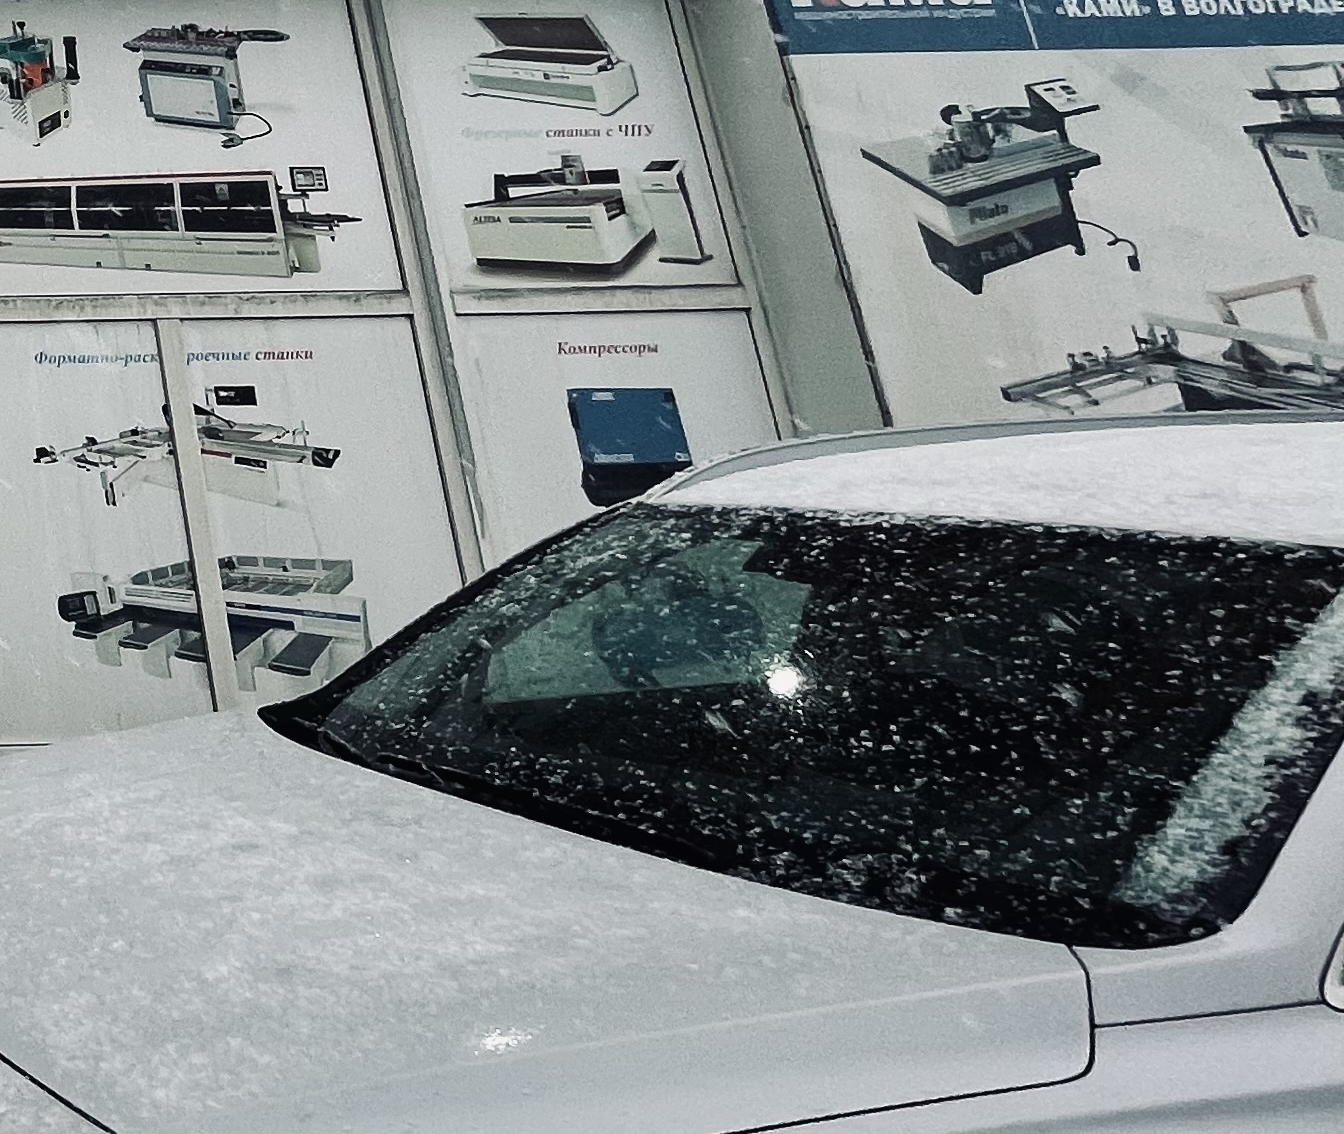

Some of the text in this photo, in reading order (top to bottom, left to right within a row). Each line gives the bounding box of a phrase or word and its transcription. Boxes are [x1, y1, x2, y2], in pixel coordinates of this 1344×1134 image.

[546, 128, 602, 138] станки
[606, 128, 614, 138] с
[618, 124, 655, 137] ЧПУ
[255, 350, 313, 361] станки
[557, 341, 658, 357] Компрессоры
